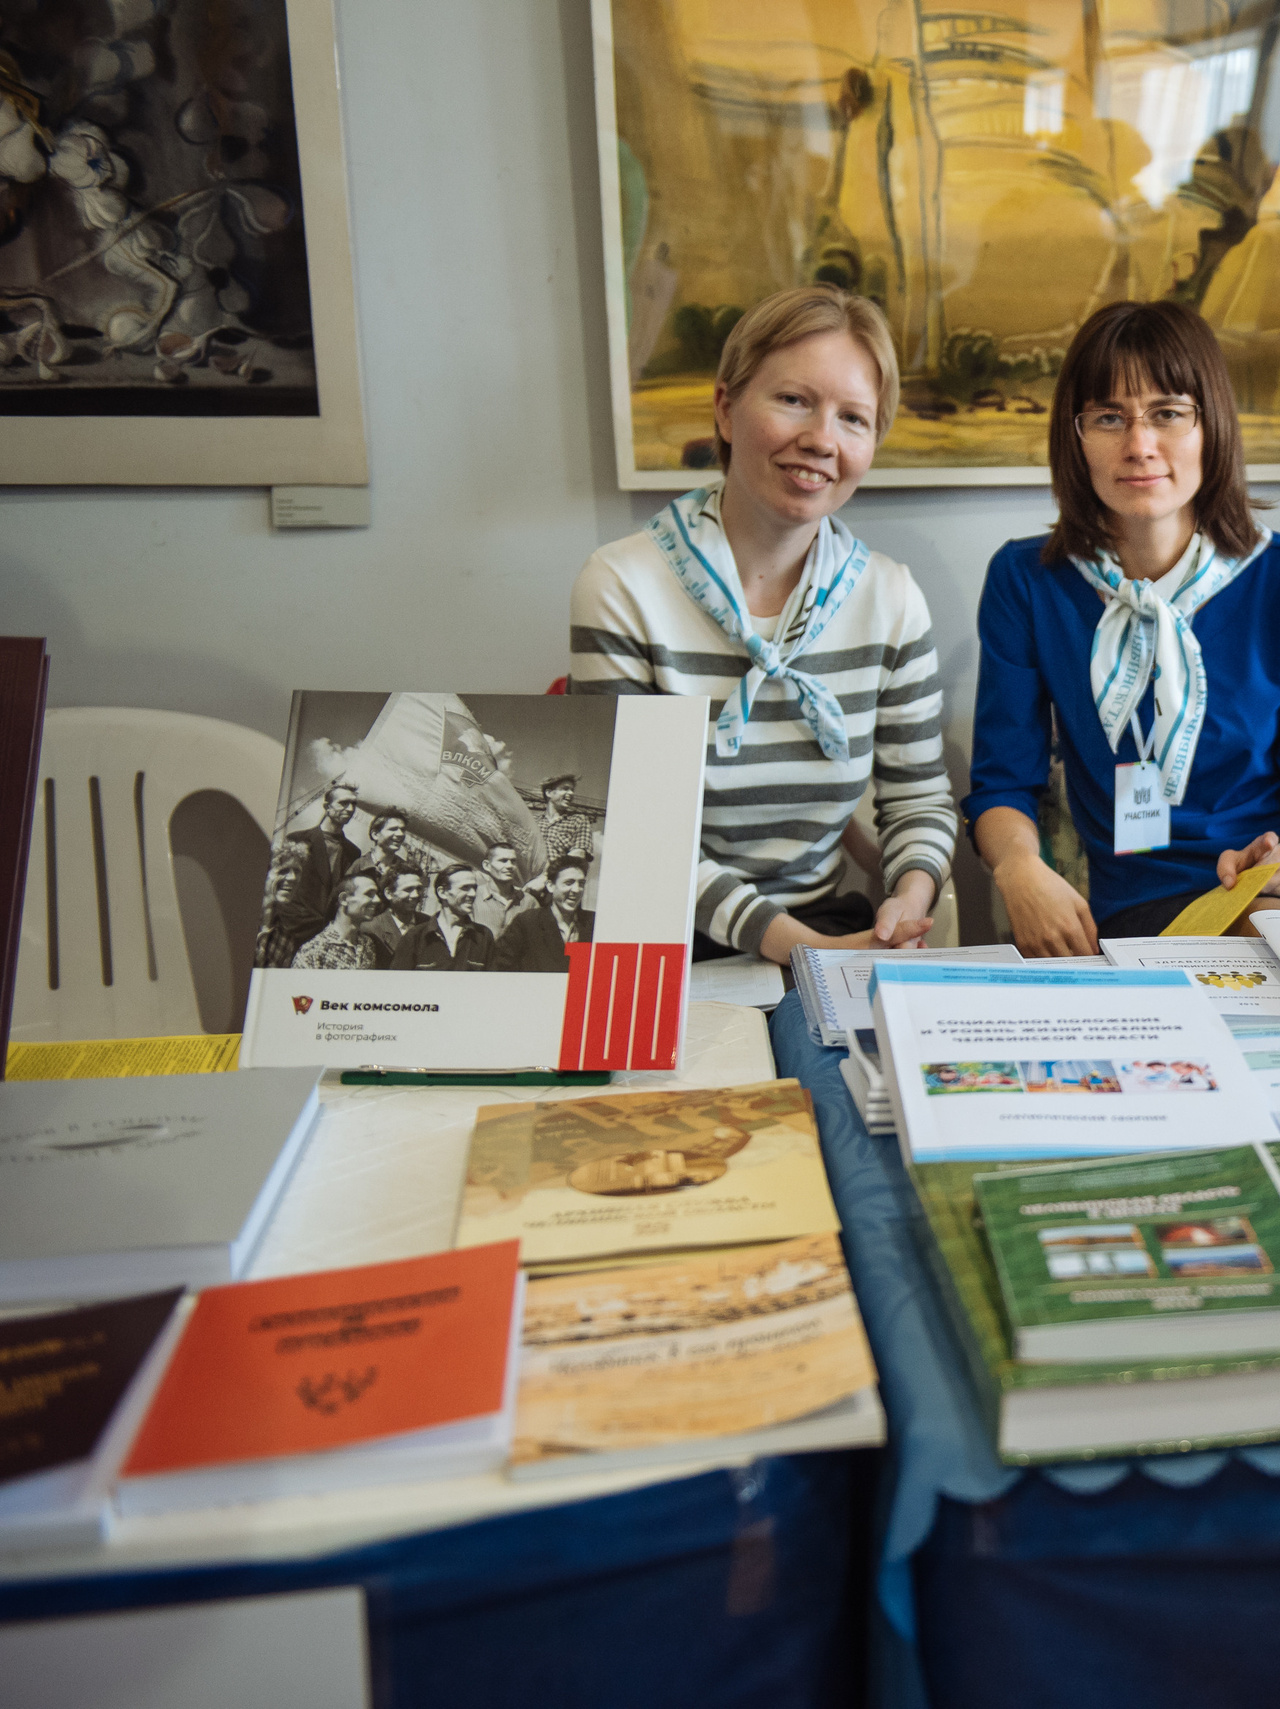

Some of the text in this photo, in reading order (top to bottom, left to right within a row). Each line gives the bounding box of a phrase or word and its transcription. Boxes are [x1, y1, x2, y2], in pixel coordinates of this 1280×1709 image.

[442, 750, 491, 779] ВЛКСМ
[1124, 809, 1161, 821] УЧАСТНИК
[320, 1000, 440, 1012] Век комсомола
[317, 1022, 364, 1032] История
[324, 1032, 398, 1042] фотографиях
